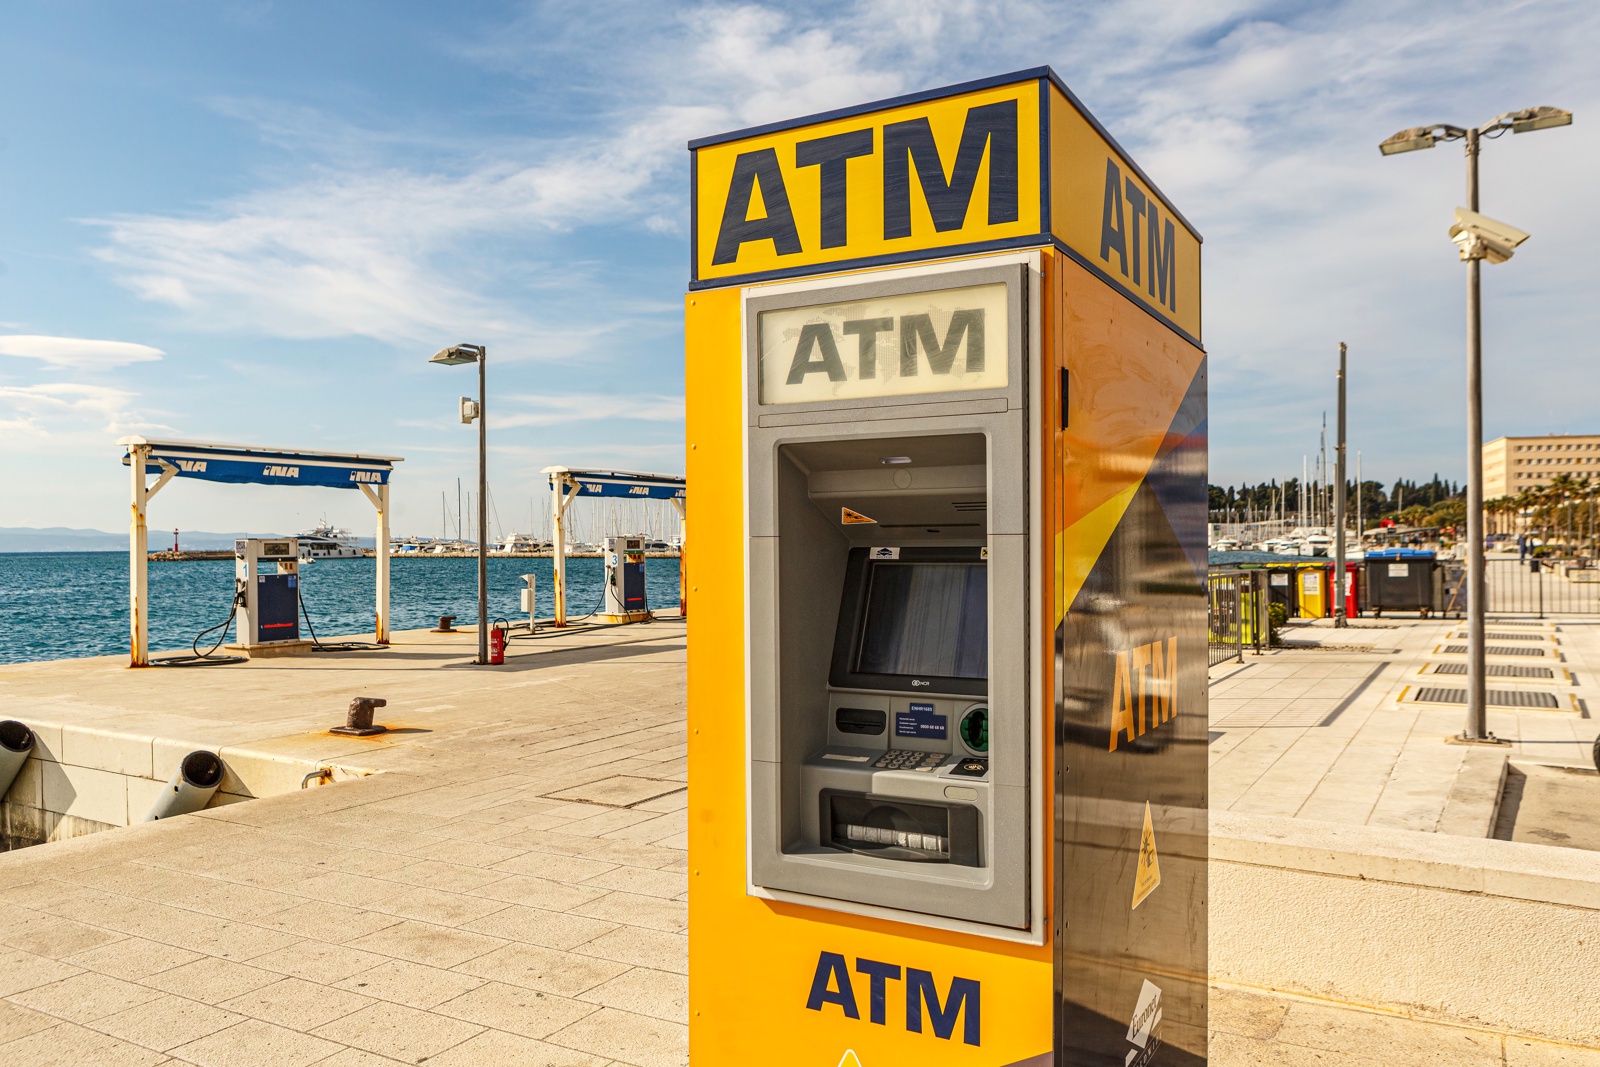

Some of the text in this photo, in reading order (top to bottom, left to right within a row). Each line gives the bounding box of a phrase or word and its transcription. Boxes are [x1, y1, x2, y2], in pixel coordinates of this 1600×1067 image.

[711, 98, 1019, 267] ATM
[1099, 157, 1176, 313] ATM
[785, 308, 985, 385] ATM
[243, 564, 248, 578] 1
[611, 555, 618, 565] 3
[1109, 636, 1177, 752] ATM
[806, 950, 981, 1047] ATM
[1132, 995, 1157, 1041] Euronet
